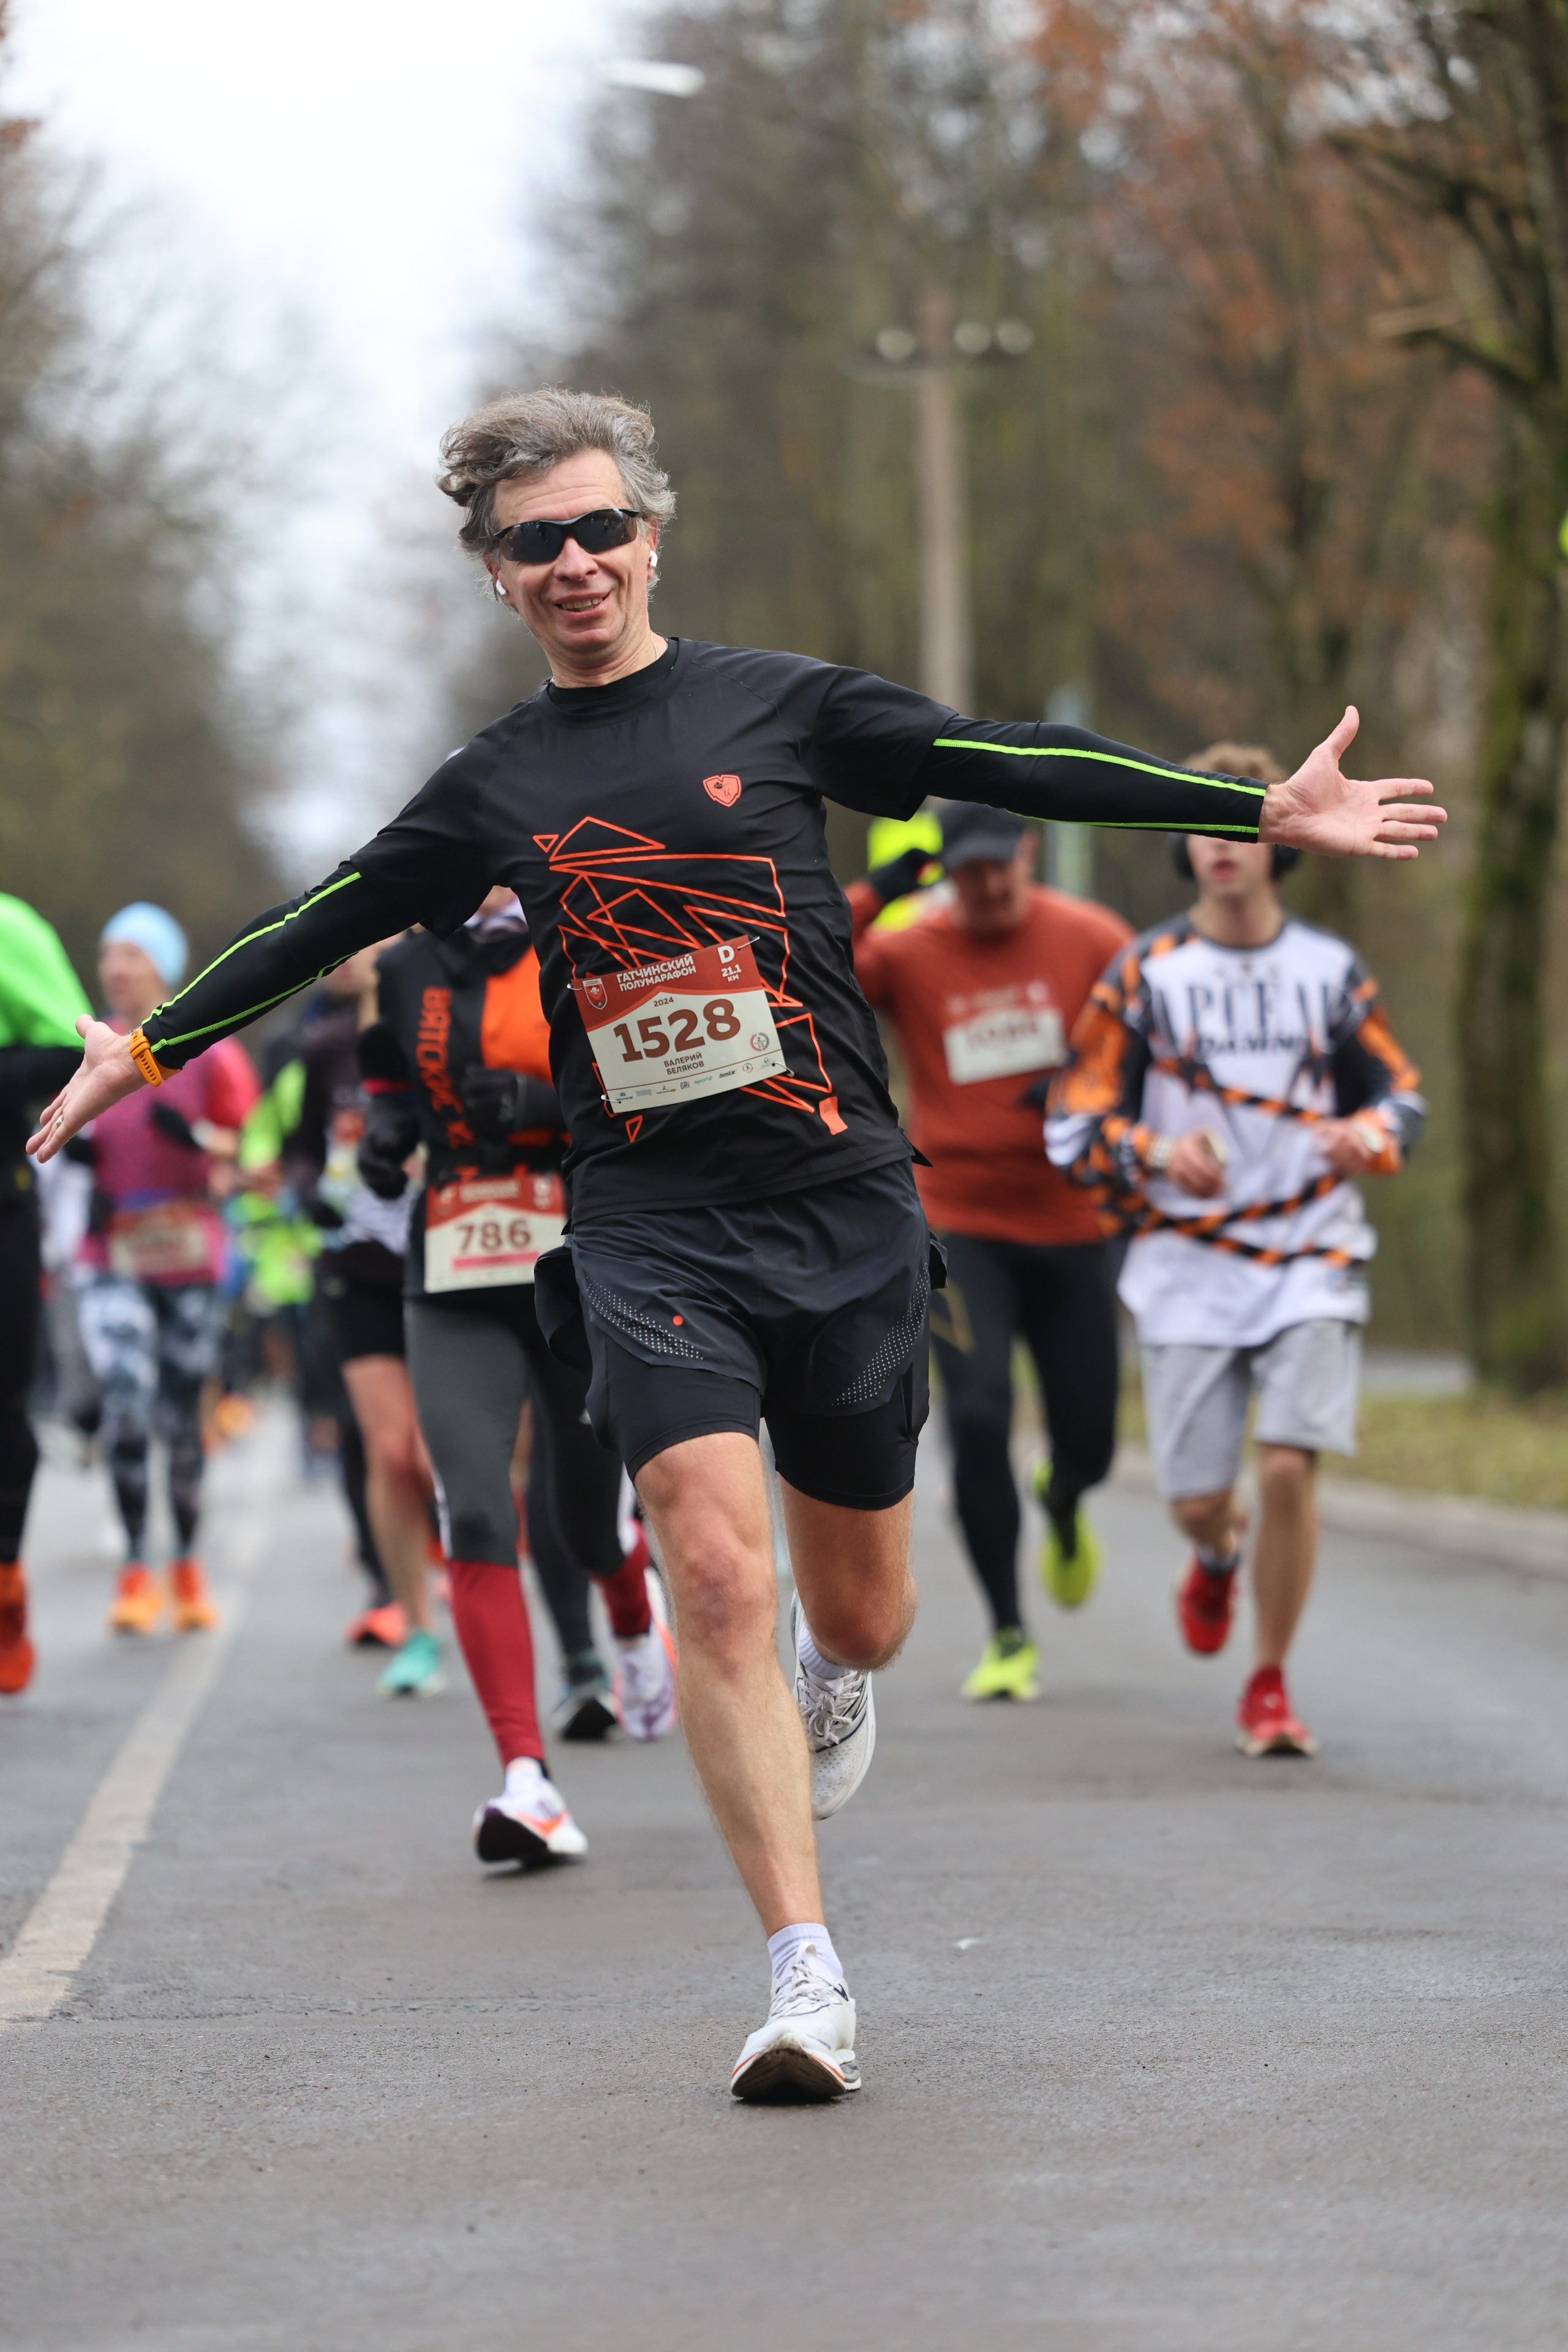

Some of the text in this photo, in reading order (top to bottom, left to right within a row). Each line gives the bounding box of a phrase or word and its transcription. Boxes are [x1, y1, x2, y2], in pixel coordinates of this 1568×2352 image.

[717, 945, 735, 964] D
[616, 953, 695, 984] ГАТЧИНСКИЙ
[721, 964, 742, 978] 21.1
[619, 965, 697, 992] ПОЛУМАРАФОН
[653, 997, 674, 1008] 2024
[613, 998, 741, 1063] 1528
[663, 1051, 703, 1067] ВАЛЕРИЙ
[666, 1061, 704, 1075] БЕЛЯКОВ
[456, 1219, 531, 1252] 786
